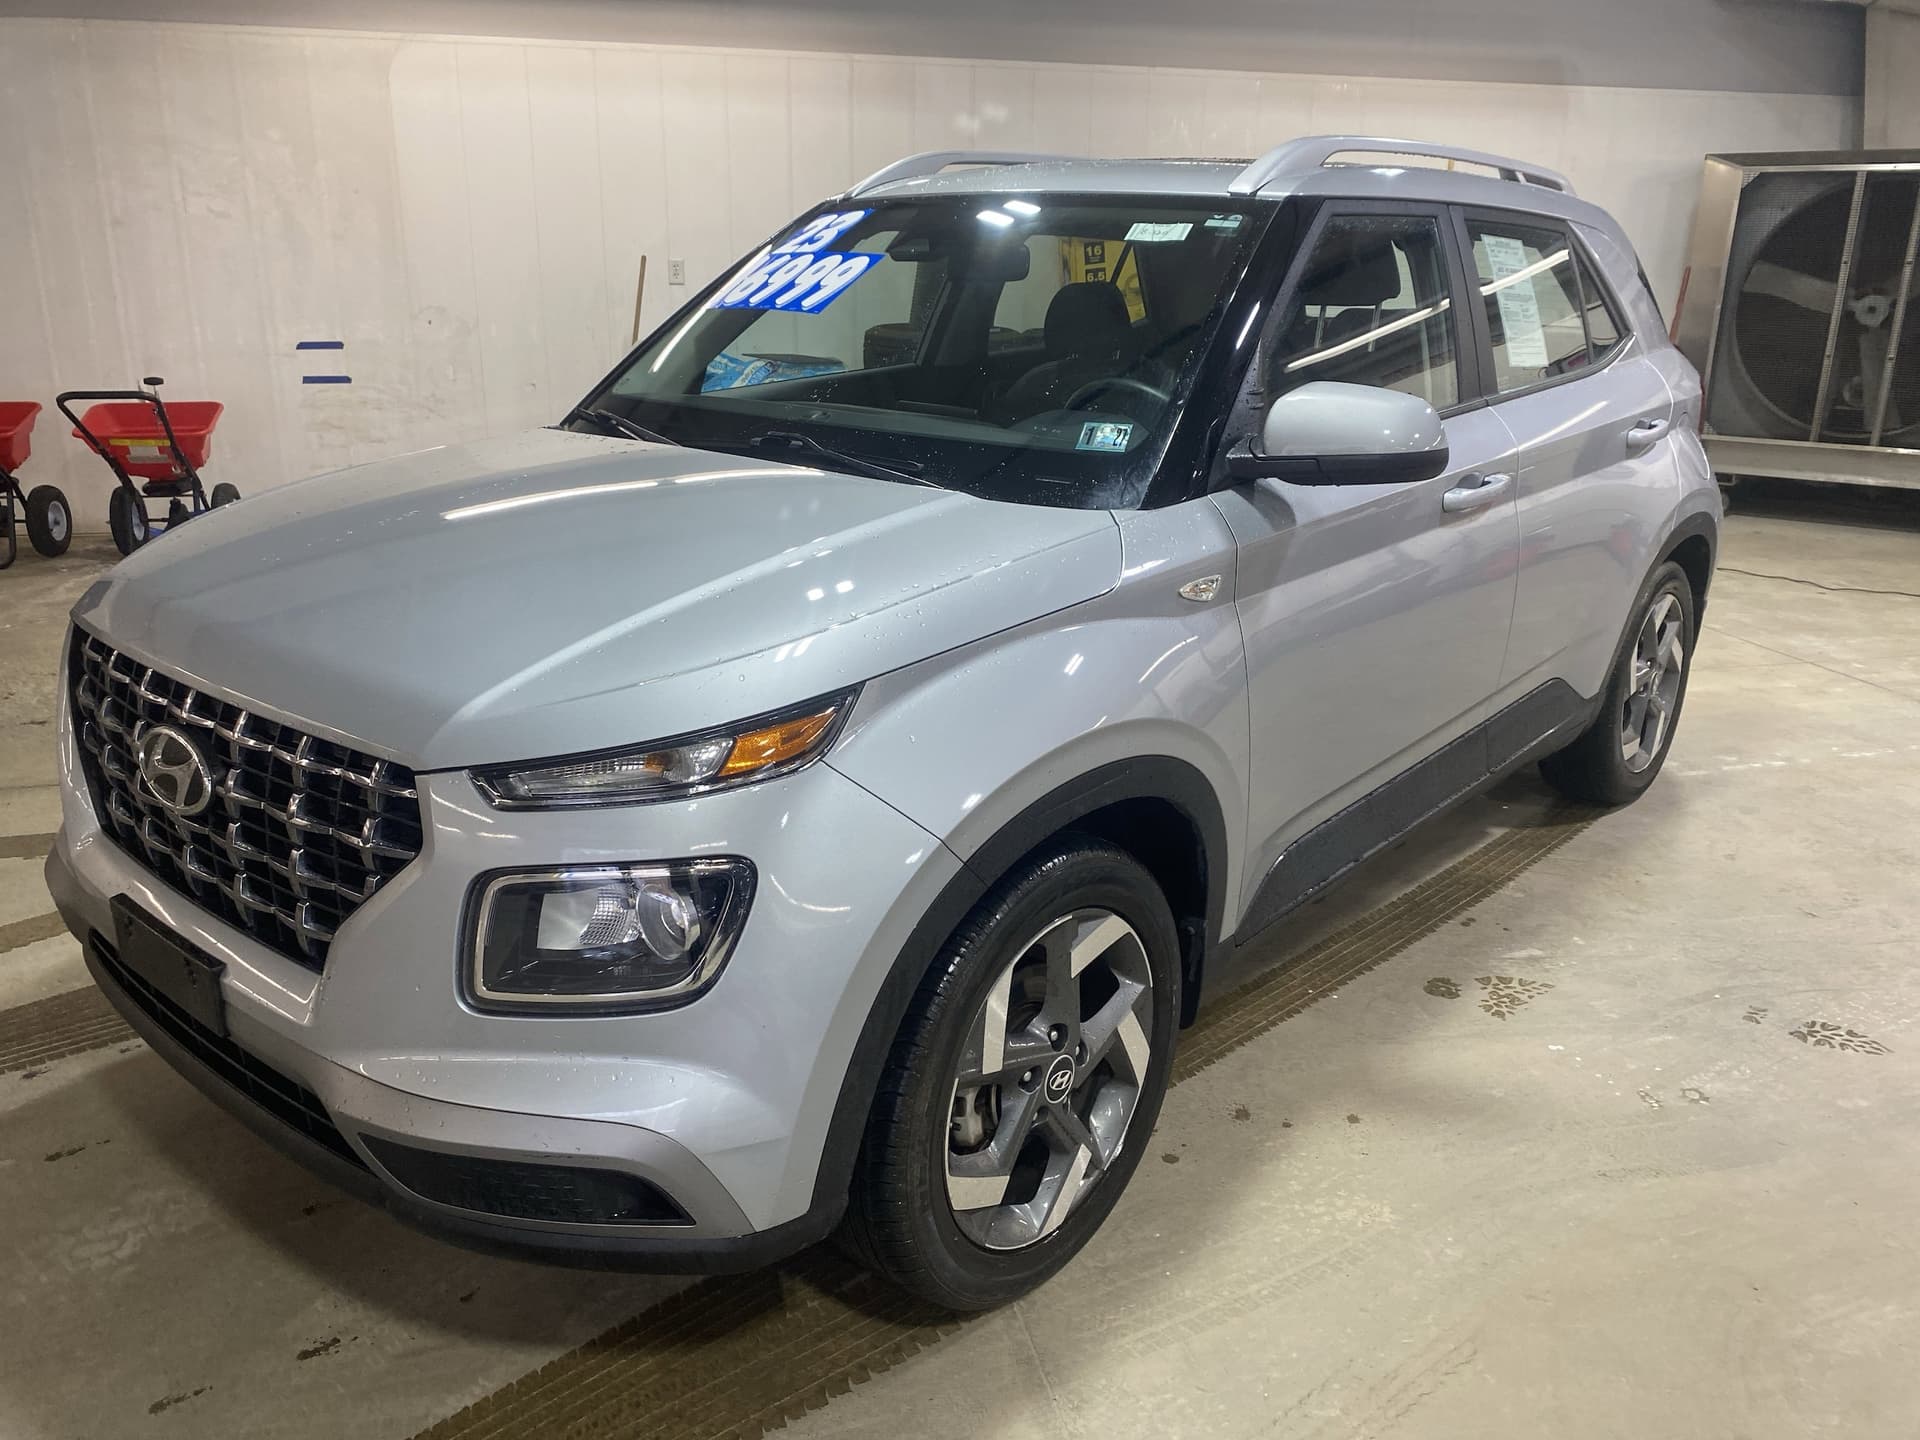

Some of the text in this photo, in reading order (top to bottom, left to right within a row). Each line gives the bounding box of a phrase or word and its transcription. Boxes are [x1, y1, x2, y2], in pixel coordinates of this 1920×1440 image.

[771, 210, 866, 254] 23
[1085, 244, 1103, 258] 16
[1086, 271, 1106, 283] 6.5
[1085, 426, 1129, 448] 1 27
